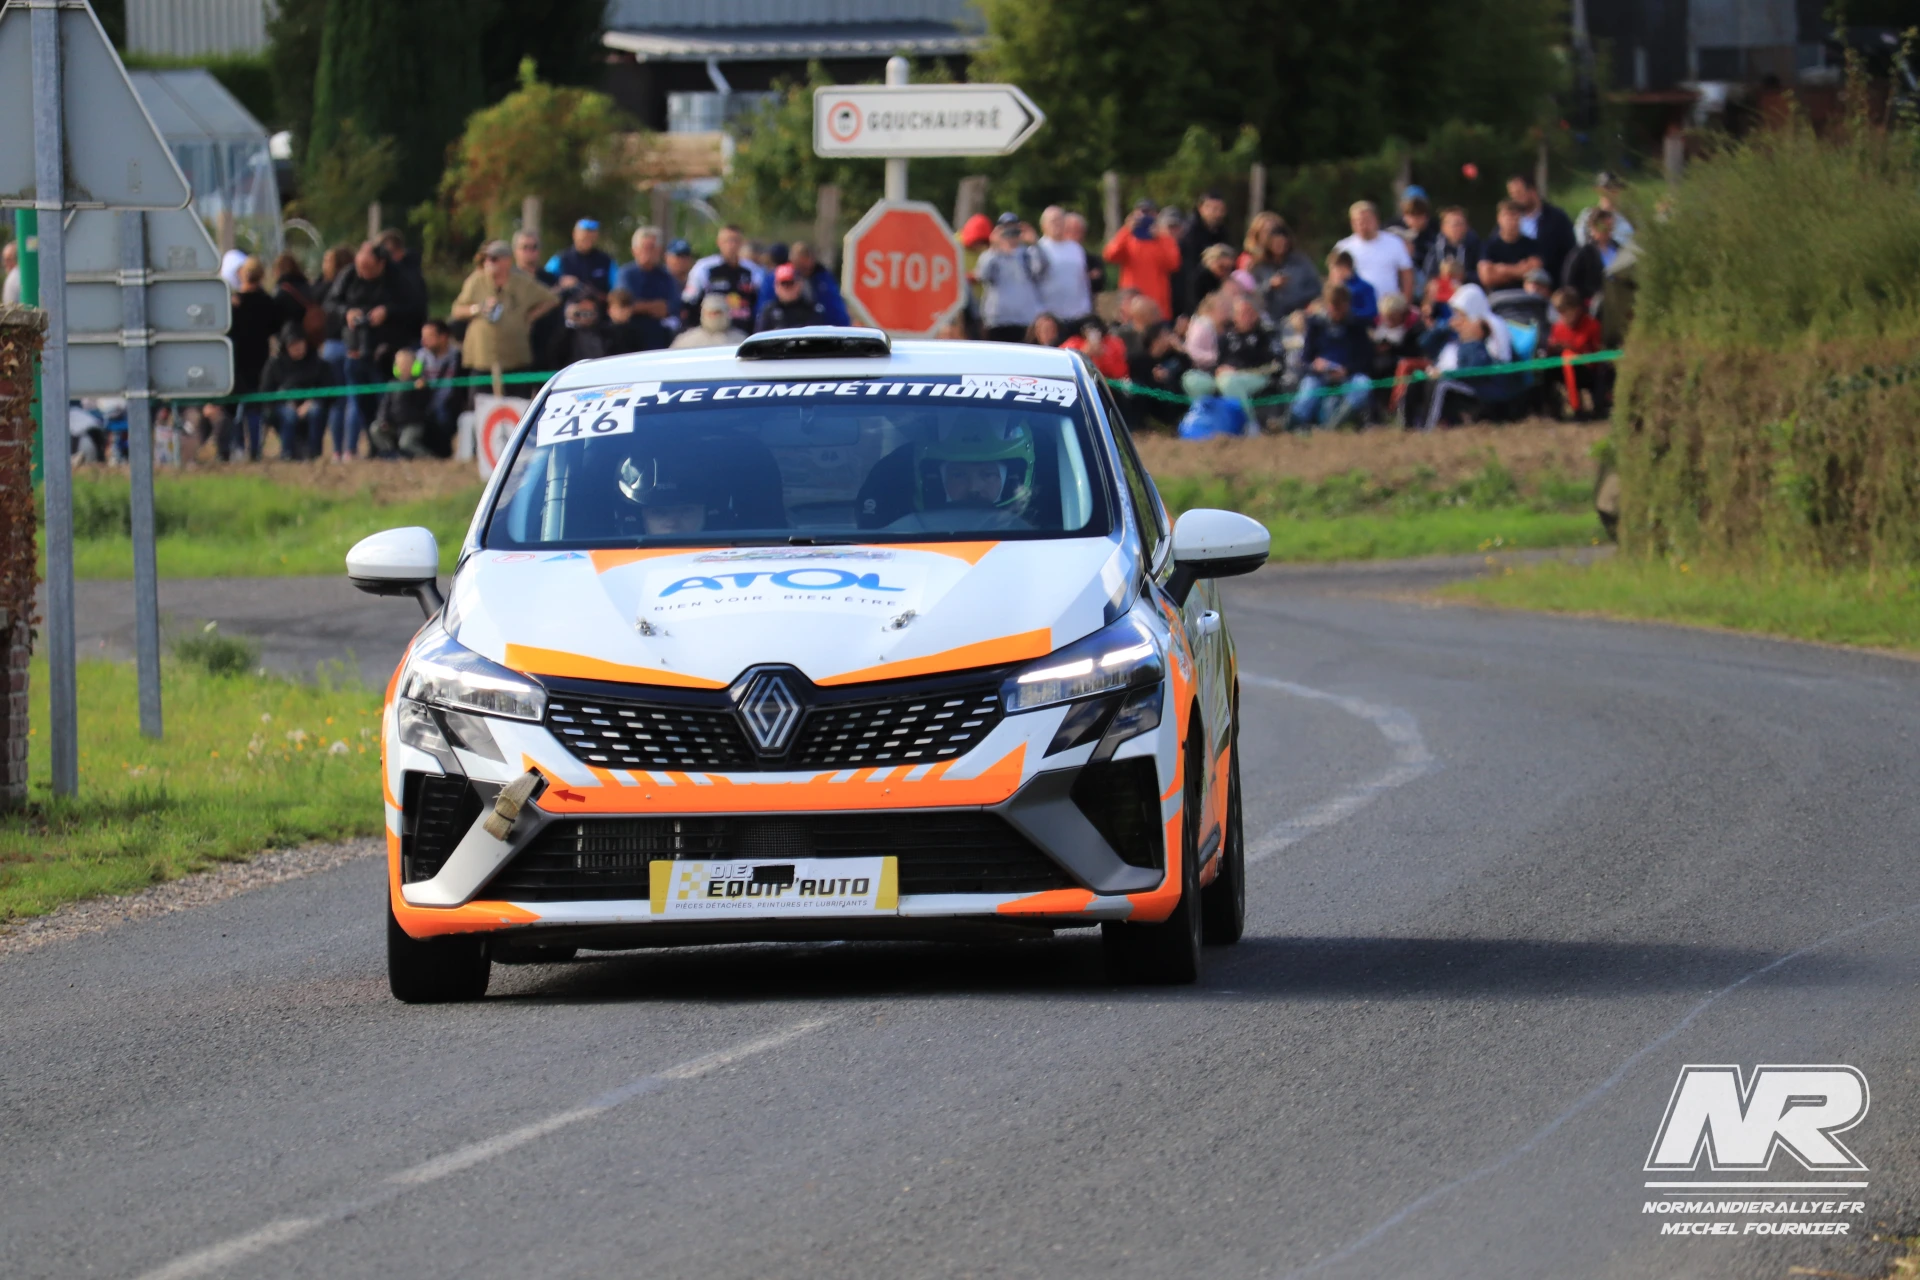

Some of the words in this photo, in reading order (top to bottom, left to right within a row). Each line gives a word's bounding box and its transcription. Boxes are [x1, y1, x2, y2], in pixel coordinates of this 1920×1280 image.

[867, 106, 1003, 131] GOUCHAUPRÉ
[861, 249, 953, 292] STOP
[553, 410, 619, 437] 46
[657, 567, 907, 598] ATOL
[654, 601, 702, 612] BIEN
[714, 595, 762, 604] VOIR
[757, 901, 801, 909] PEINTURES
[803, 900, 813, 908] ET
[816, 900, 868, 908] LUBRIFIANTS
